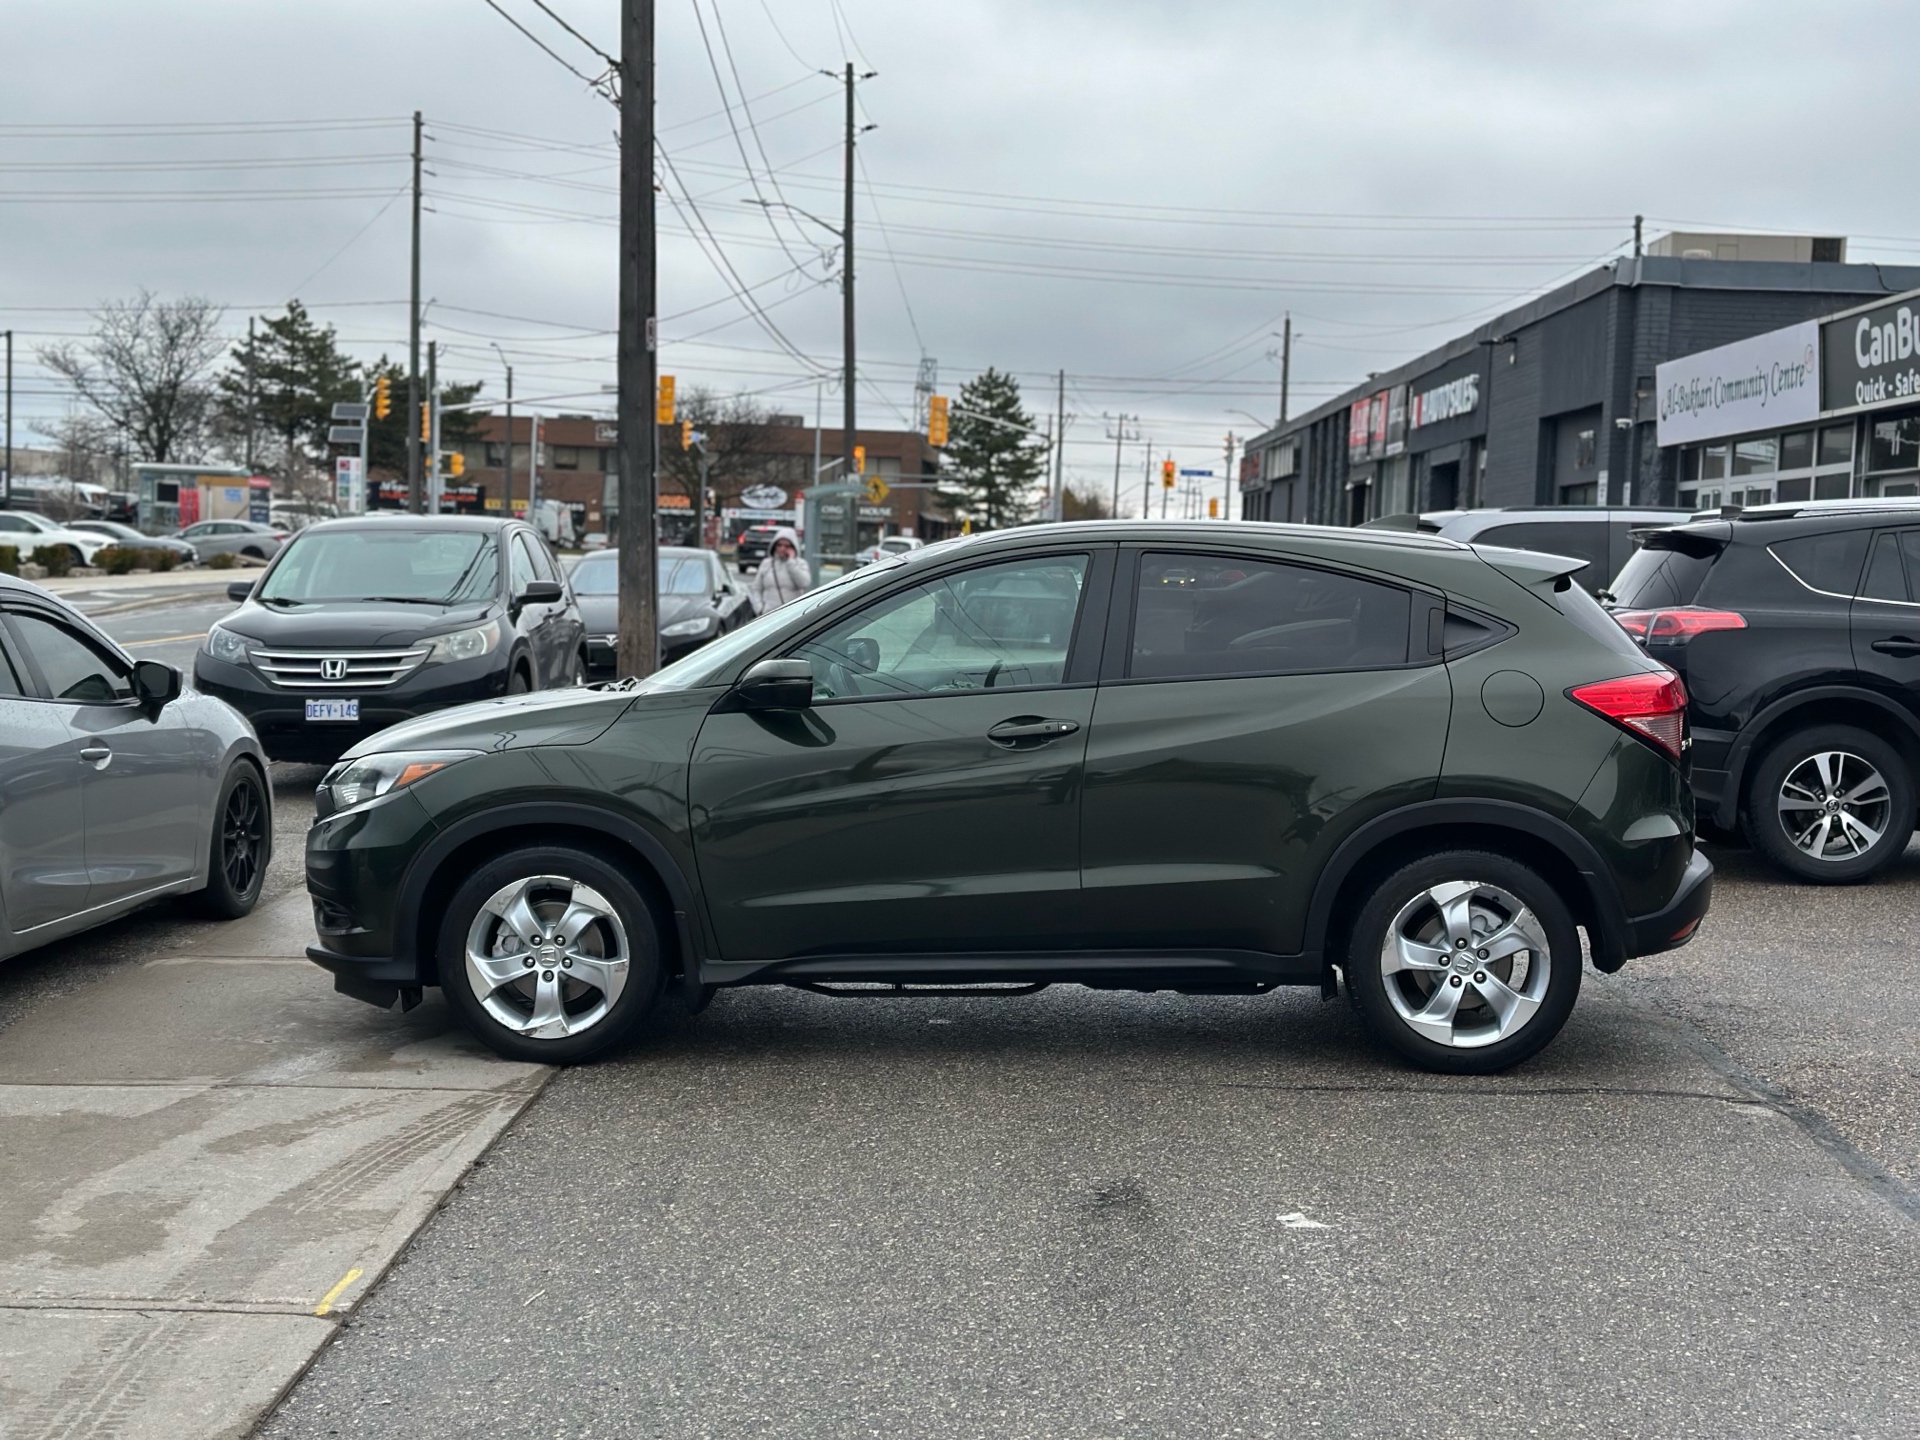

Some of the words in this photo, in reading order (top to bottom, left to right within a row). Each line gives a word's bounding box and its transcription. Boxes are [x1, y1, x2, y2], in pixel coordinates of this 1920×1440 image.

[1661, 377, 1713, 421] Al-Bukhari
[1714, 366, 1769, 409] Community
[1771, 361, 1805, 397] Centre
[1856, 375, 1886, 406] Quick
[1895, 368, 1920, 397] Safe
